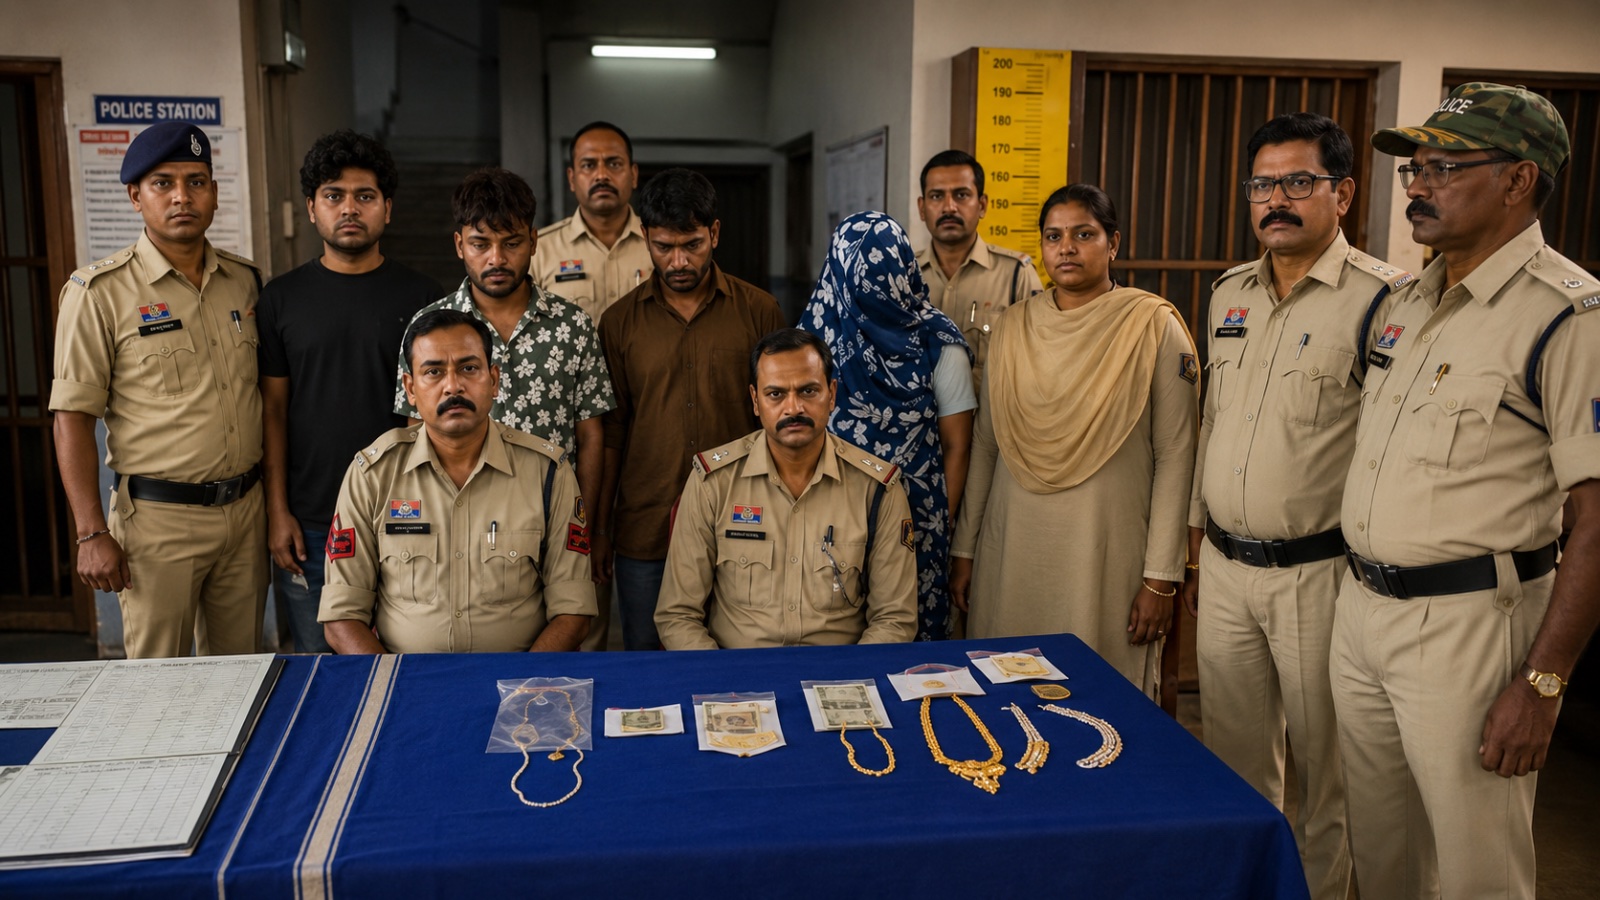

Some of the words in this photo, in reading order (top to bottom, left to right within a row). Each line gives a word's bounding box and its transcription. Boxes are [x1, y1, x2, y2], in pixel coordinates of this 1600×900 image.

[992, 58, 1013, 69] 200
[992, 86, 1012, 98] 190
[100, 101, 153, 119] POLICE
[157, 102, 216, 120] STATION
[992, 115, 1012, 126] 180
[991, 143, 1010, 154] 170
[990, 172, 1010, 182] 160
[989, 226, 1008, 236] 150
